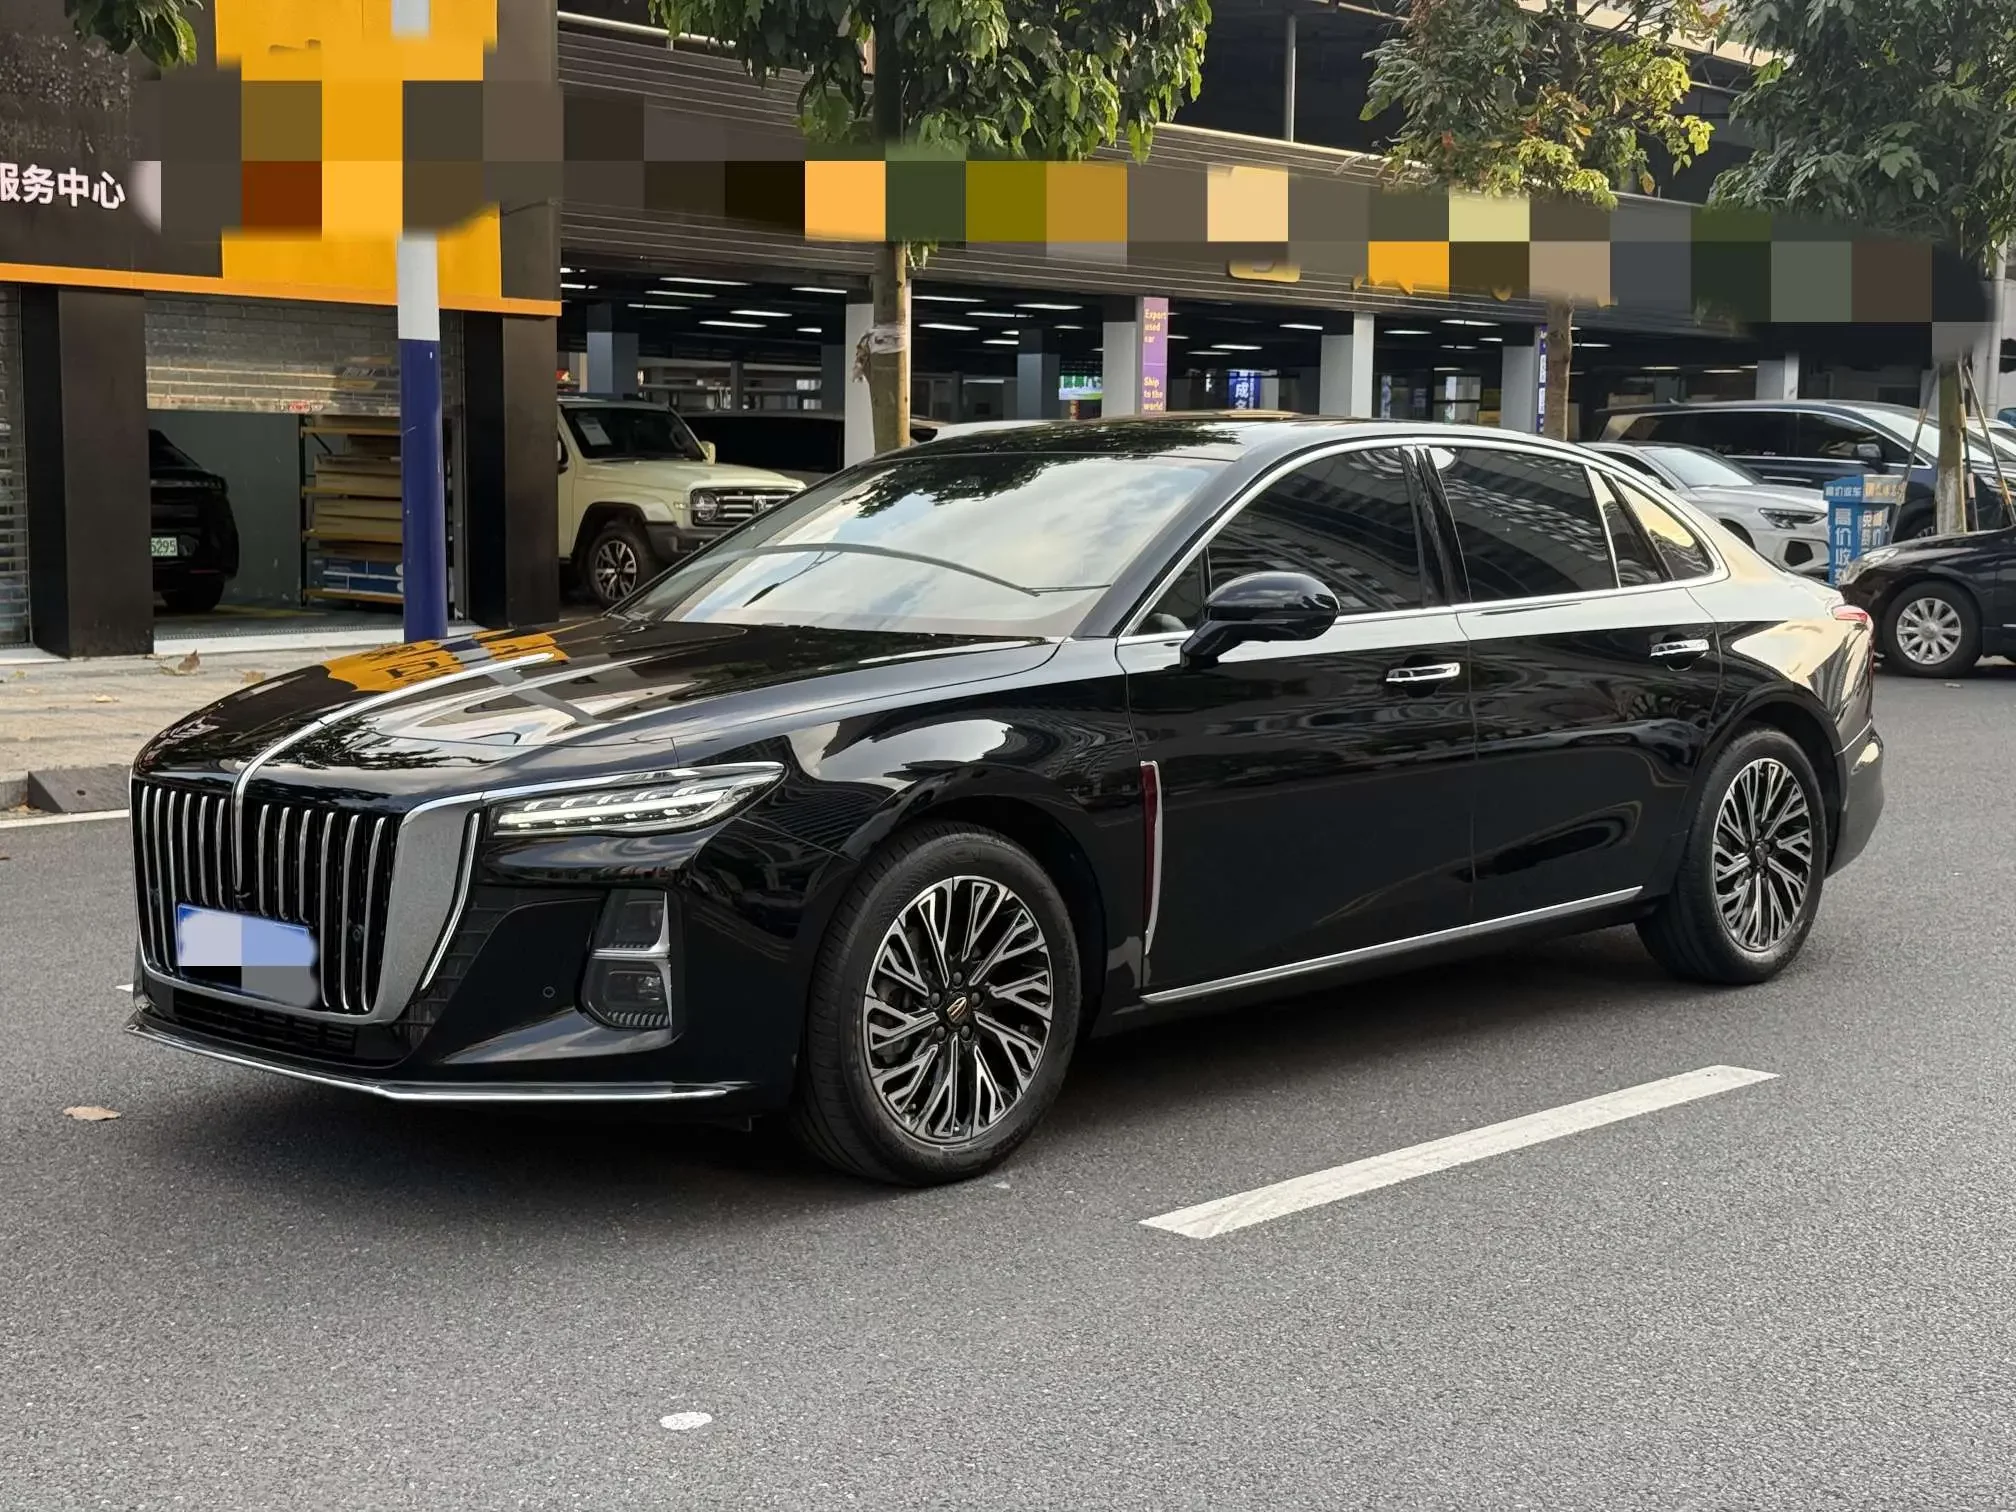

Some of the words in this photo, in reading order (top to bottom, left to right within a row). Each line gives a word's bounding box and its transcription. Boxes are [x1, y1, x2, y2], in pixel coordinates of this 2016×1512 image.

[0, 162, 126, 209] 服务中心
[1143, 376, 1160, 388] Ship
